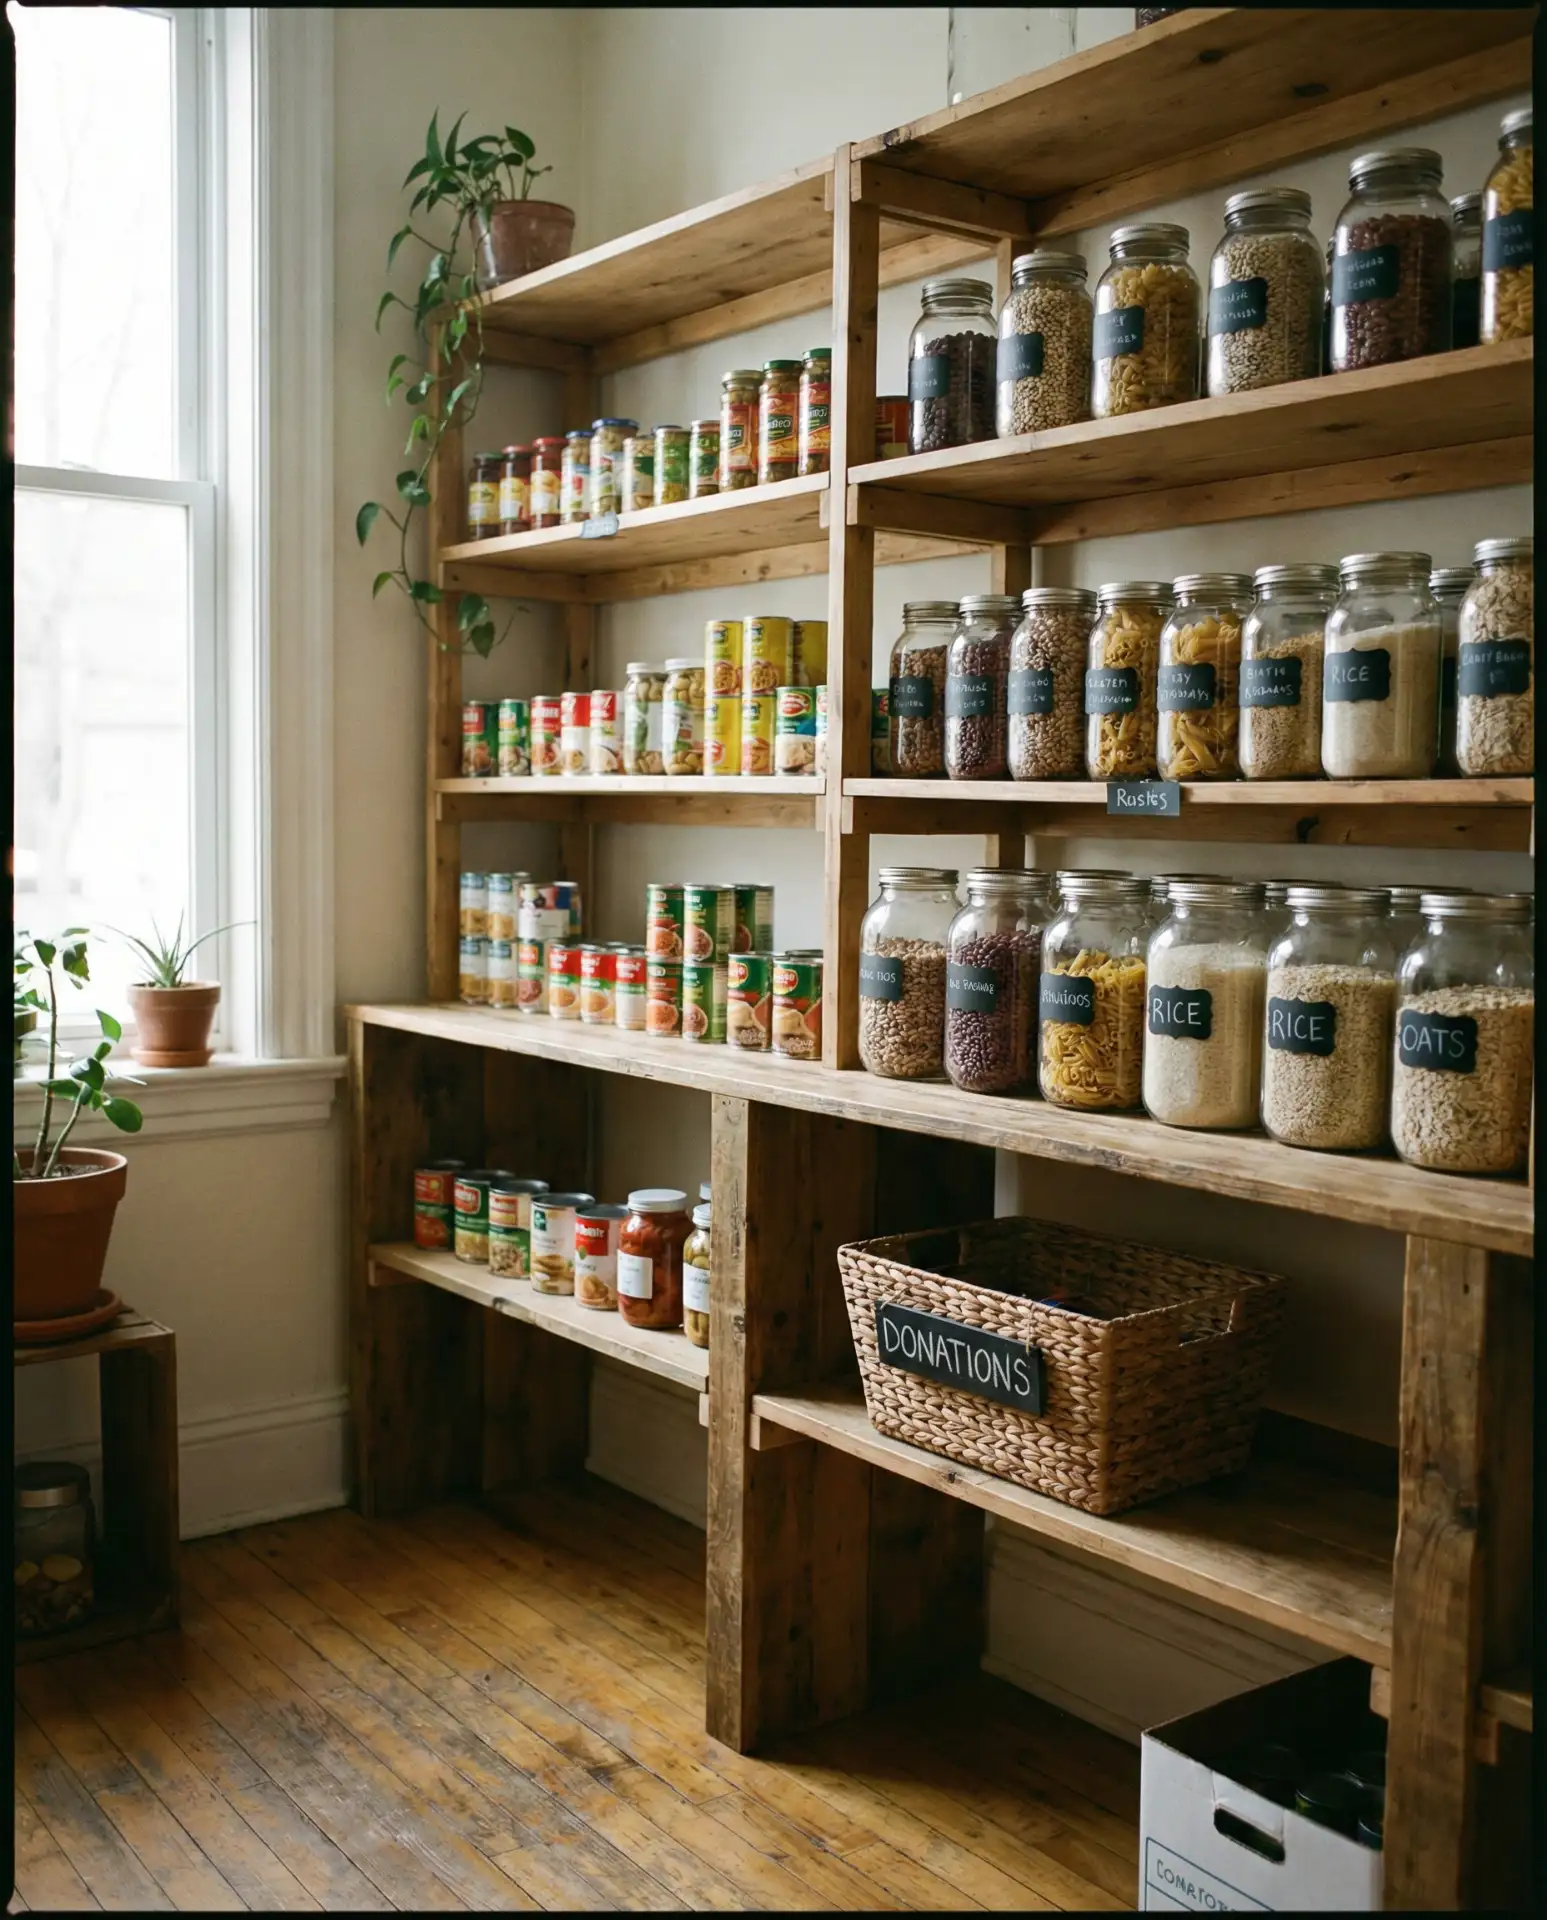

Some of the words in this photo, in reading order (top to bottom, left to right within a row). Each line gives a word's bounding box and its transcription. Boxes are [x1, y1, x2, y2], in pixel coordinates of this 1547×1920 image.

[1331, 665, 1371, 684] RICE
[1152, 997, 1202, 1026] RICE
[1271, 1008, 1326, 1042] RICE
[1402, 1024, 1466, 1059] OATS
[883, 1317, 1030, 1396] DONATIONS
